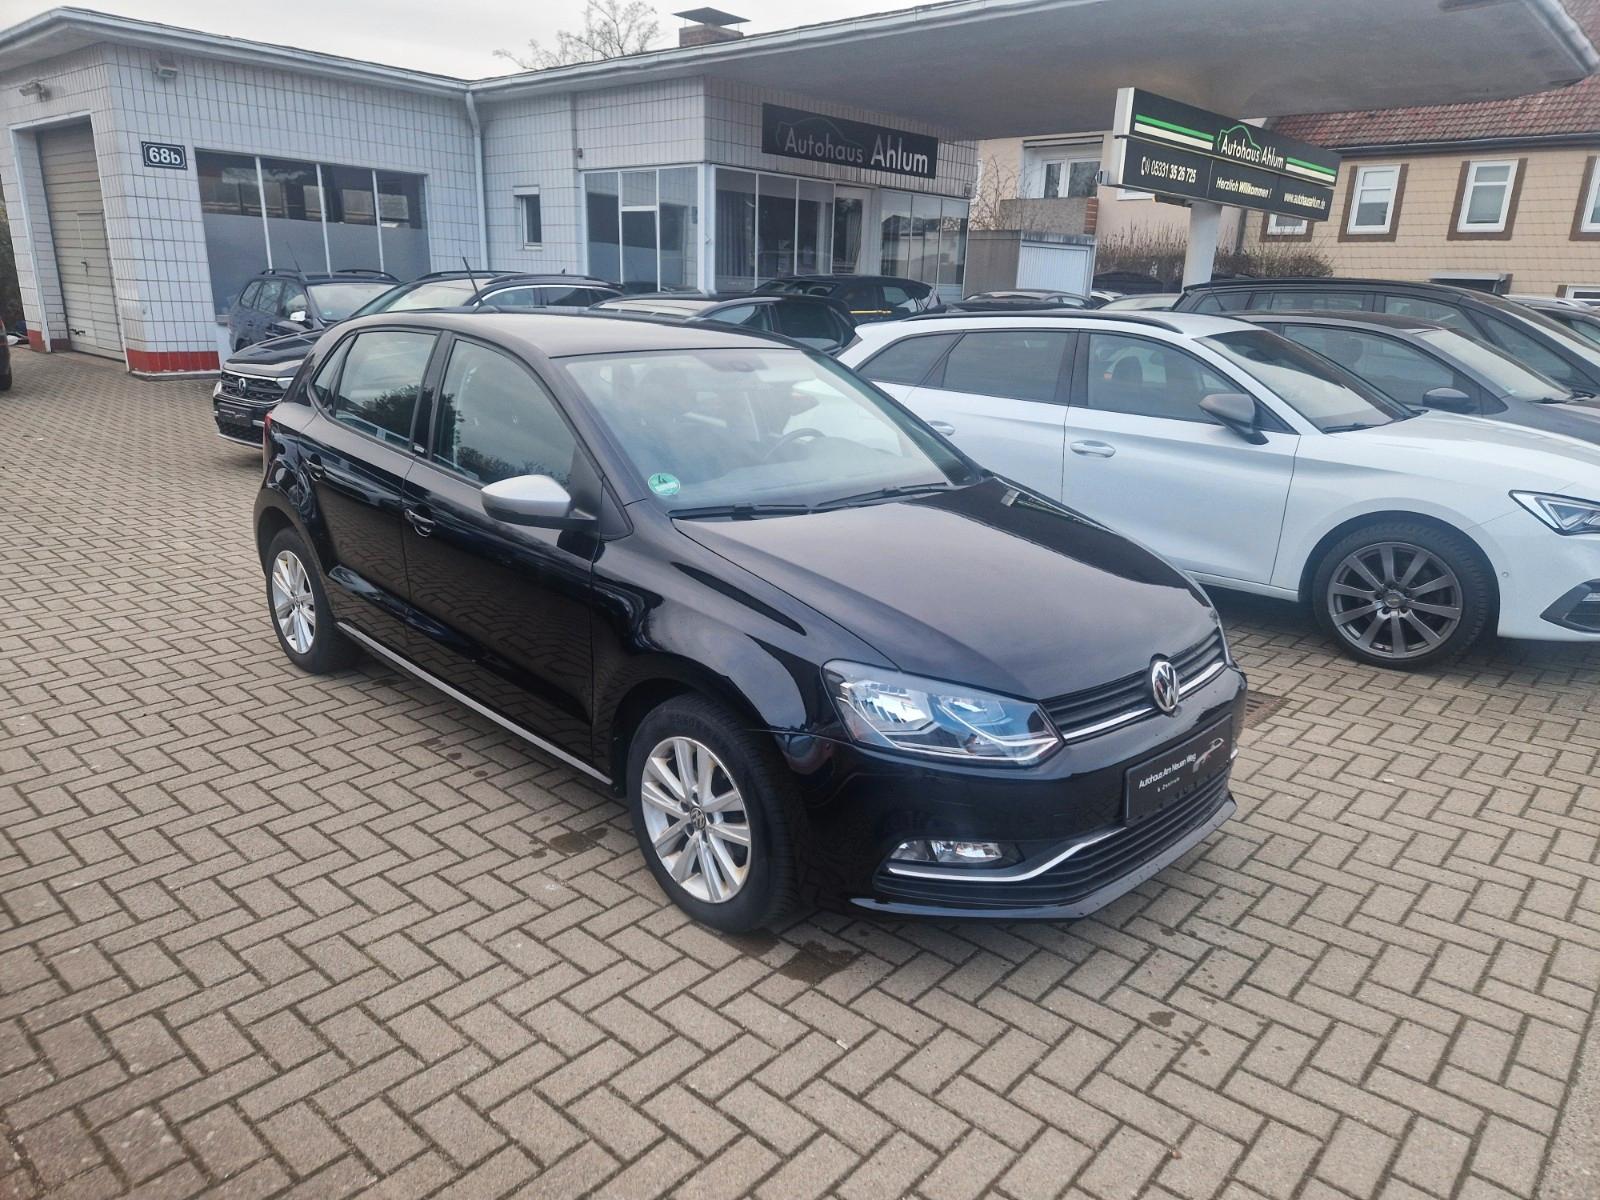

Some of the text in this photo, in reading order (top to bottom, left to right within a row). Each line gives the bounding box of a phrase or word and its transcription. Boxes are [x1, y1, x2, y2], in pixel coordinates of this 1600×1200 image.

[149, 147, 181, 164] 68b
[784, 127, 928, 173] Autohaus Ahlum
[1221, 135, 1284, 169] Autohaus Ahlum
[1150, 160, 1197, 184] 05331 35 26 725
[1216, 177, 1239, 192] Herzlich
[1238, 182, 1269, 199] Willkommen
[1138, 771, 1163, 790] Autohaus
[1163, 767, 1172, 777] Am
